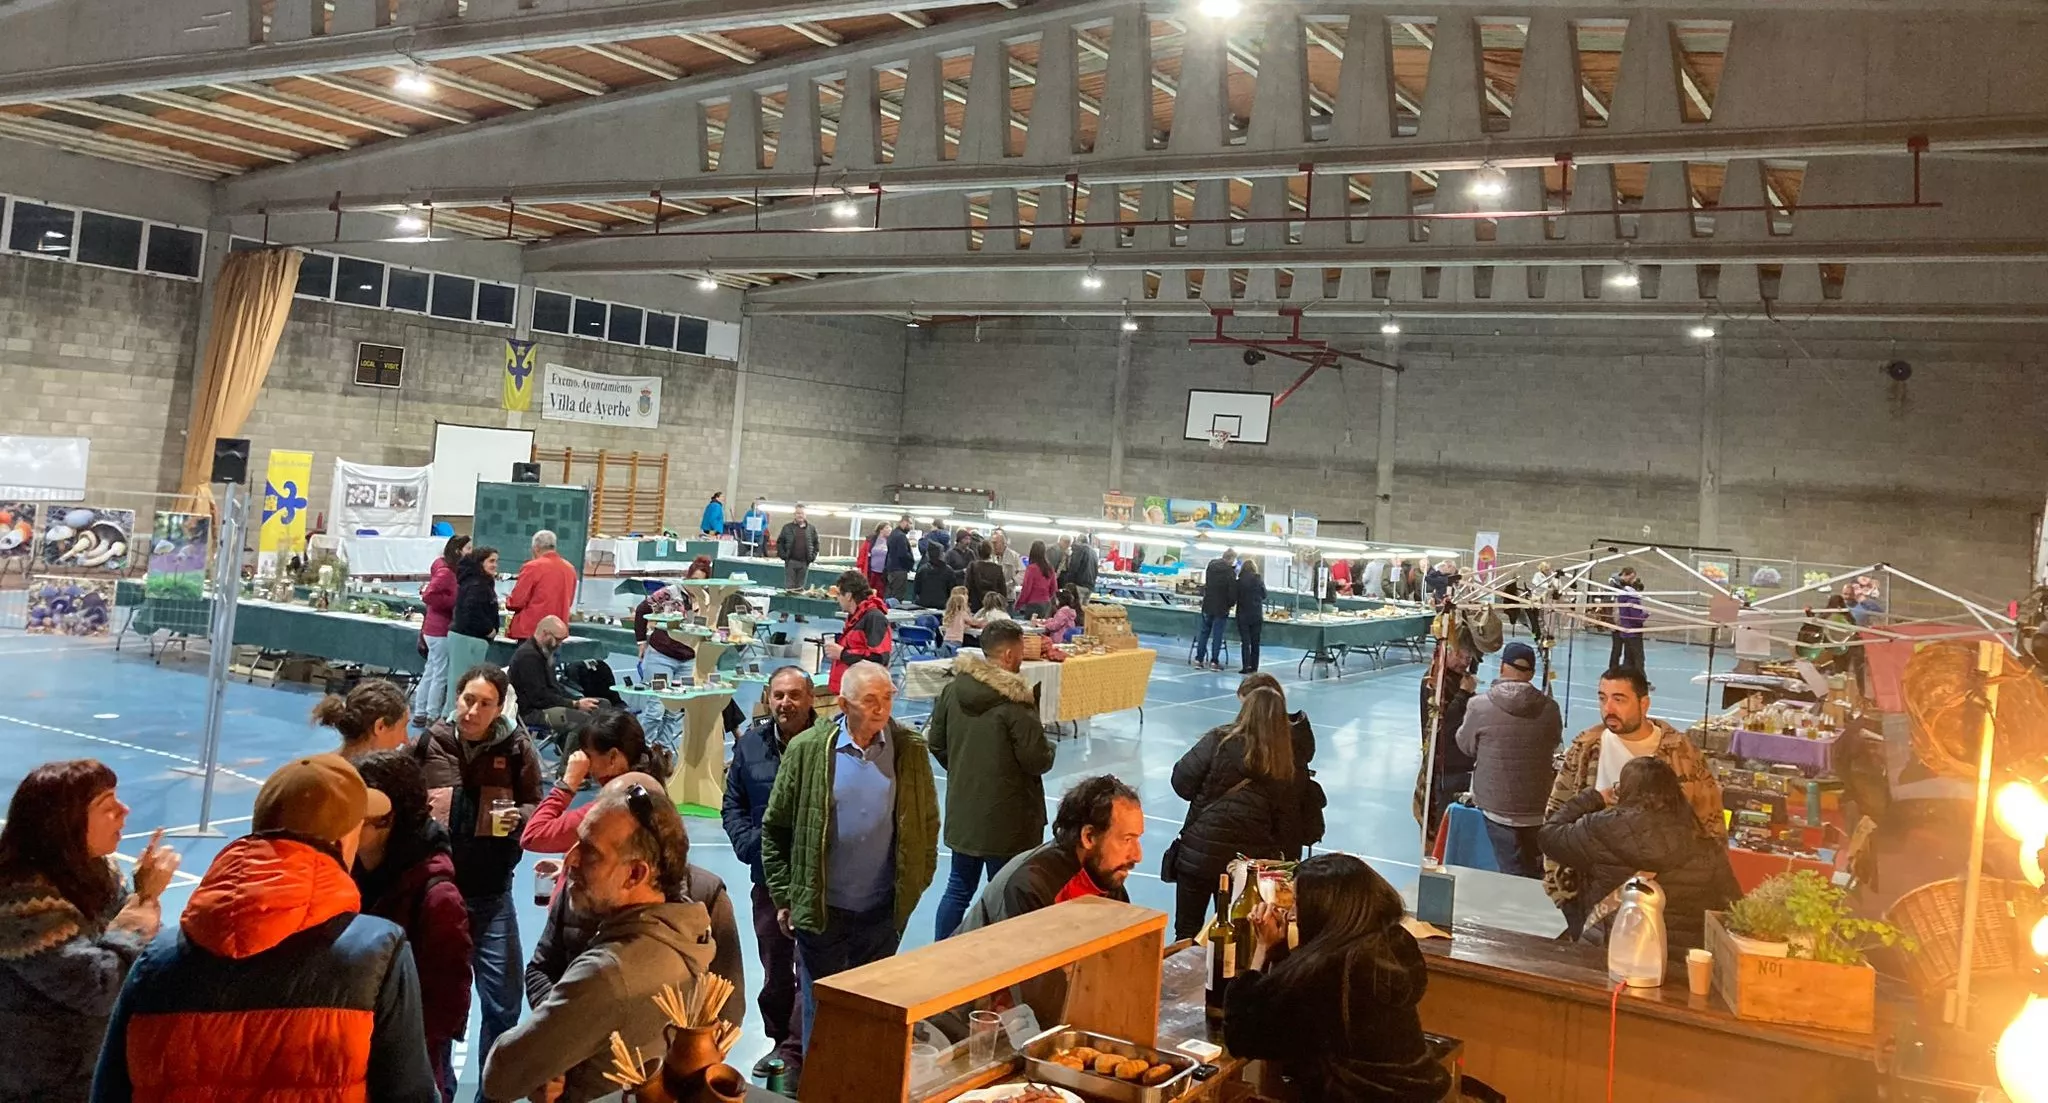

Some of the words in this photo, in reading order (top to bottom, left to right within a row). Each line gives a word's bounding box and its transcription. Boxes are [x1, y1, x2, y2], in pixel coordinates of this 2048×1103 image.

[360, 359, 376, 368] LOCAL
[581, 378, 633, 394] Ayuntamiento
[550, 392, 576, 412] Villa
[578, 396, 592, 414] de
[594, 398, 631, 419] Ayerbe
